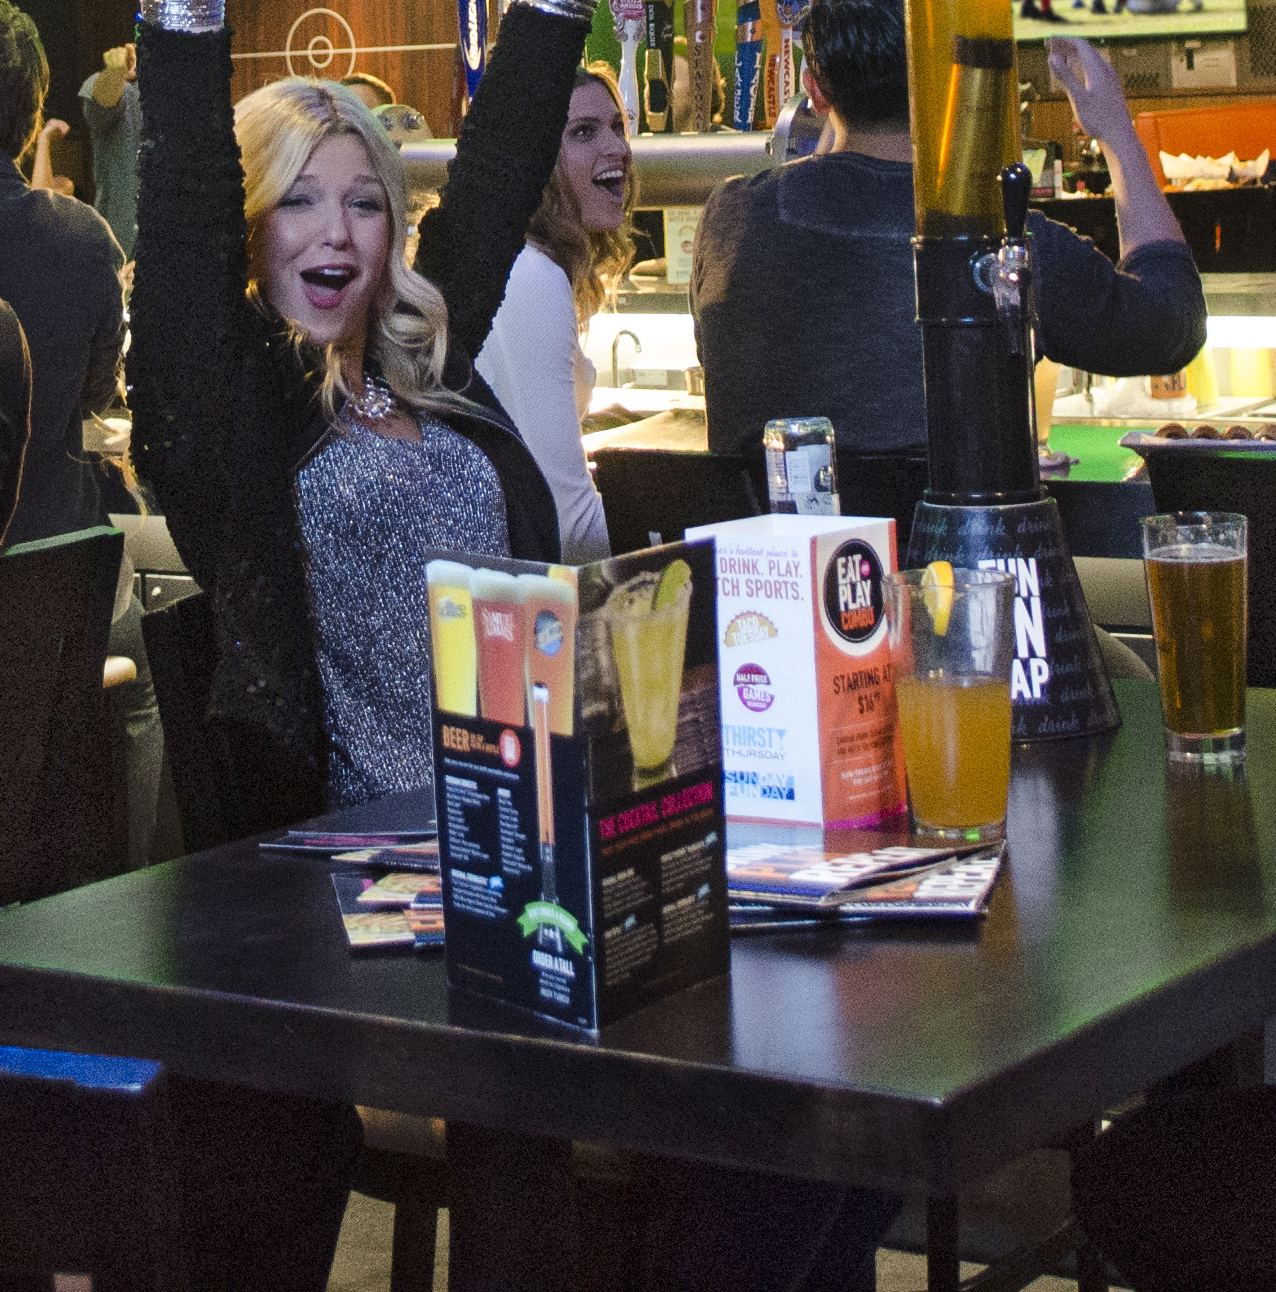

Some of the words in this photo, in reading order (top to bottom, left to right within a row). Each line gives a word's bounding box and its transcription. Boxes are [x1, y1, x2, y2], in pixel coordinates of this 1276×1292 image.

[720, 558, 764, 576] DRINK.
[769, 559, 803, 579] PLAY.
[837, 554, 862, 582] EAT
[745, 579, 805, 601] SPORTS.
[840, 579, 873, 611] PLAY
[737, 616, 760, 629] TACO
[840, 607, 875, 632] COMBO
[731, 625, 770, 647] TUESDAY
[833, 668, 880, 694] STARTING
[881, 664, 893, 682] AT
[742, 686, 772, 701] GAMES
[442, 725, 471, 753] BEER
